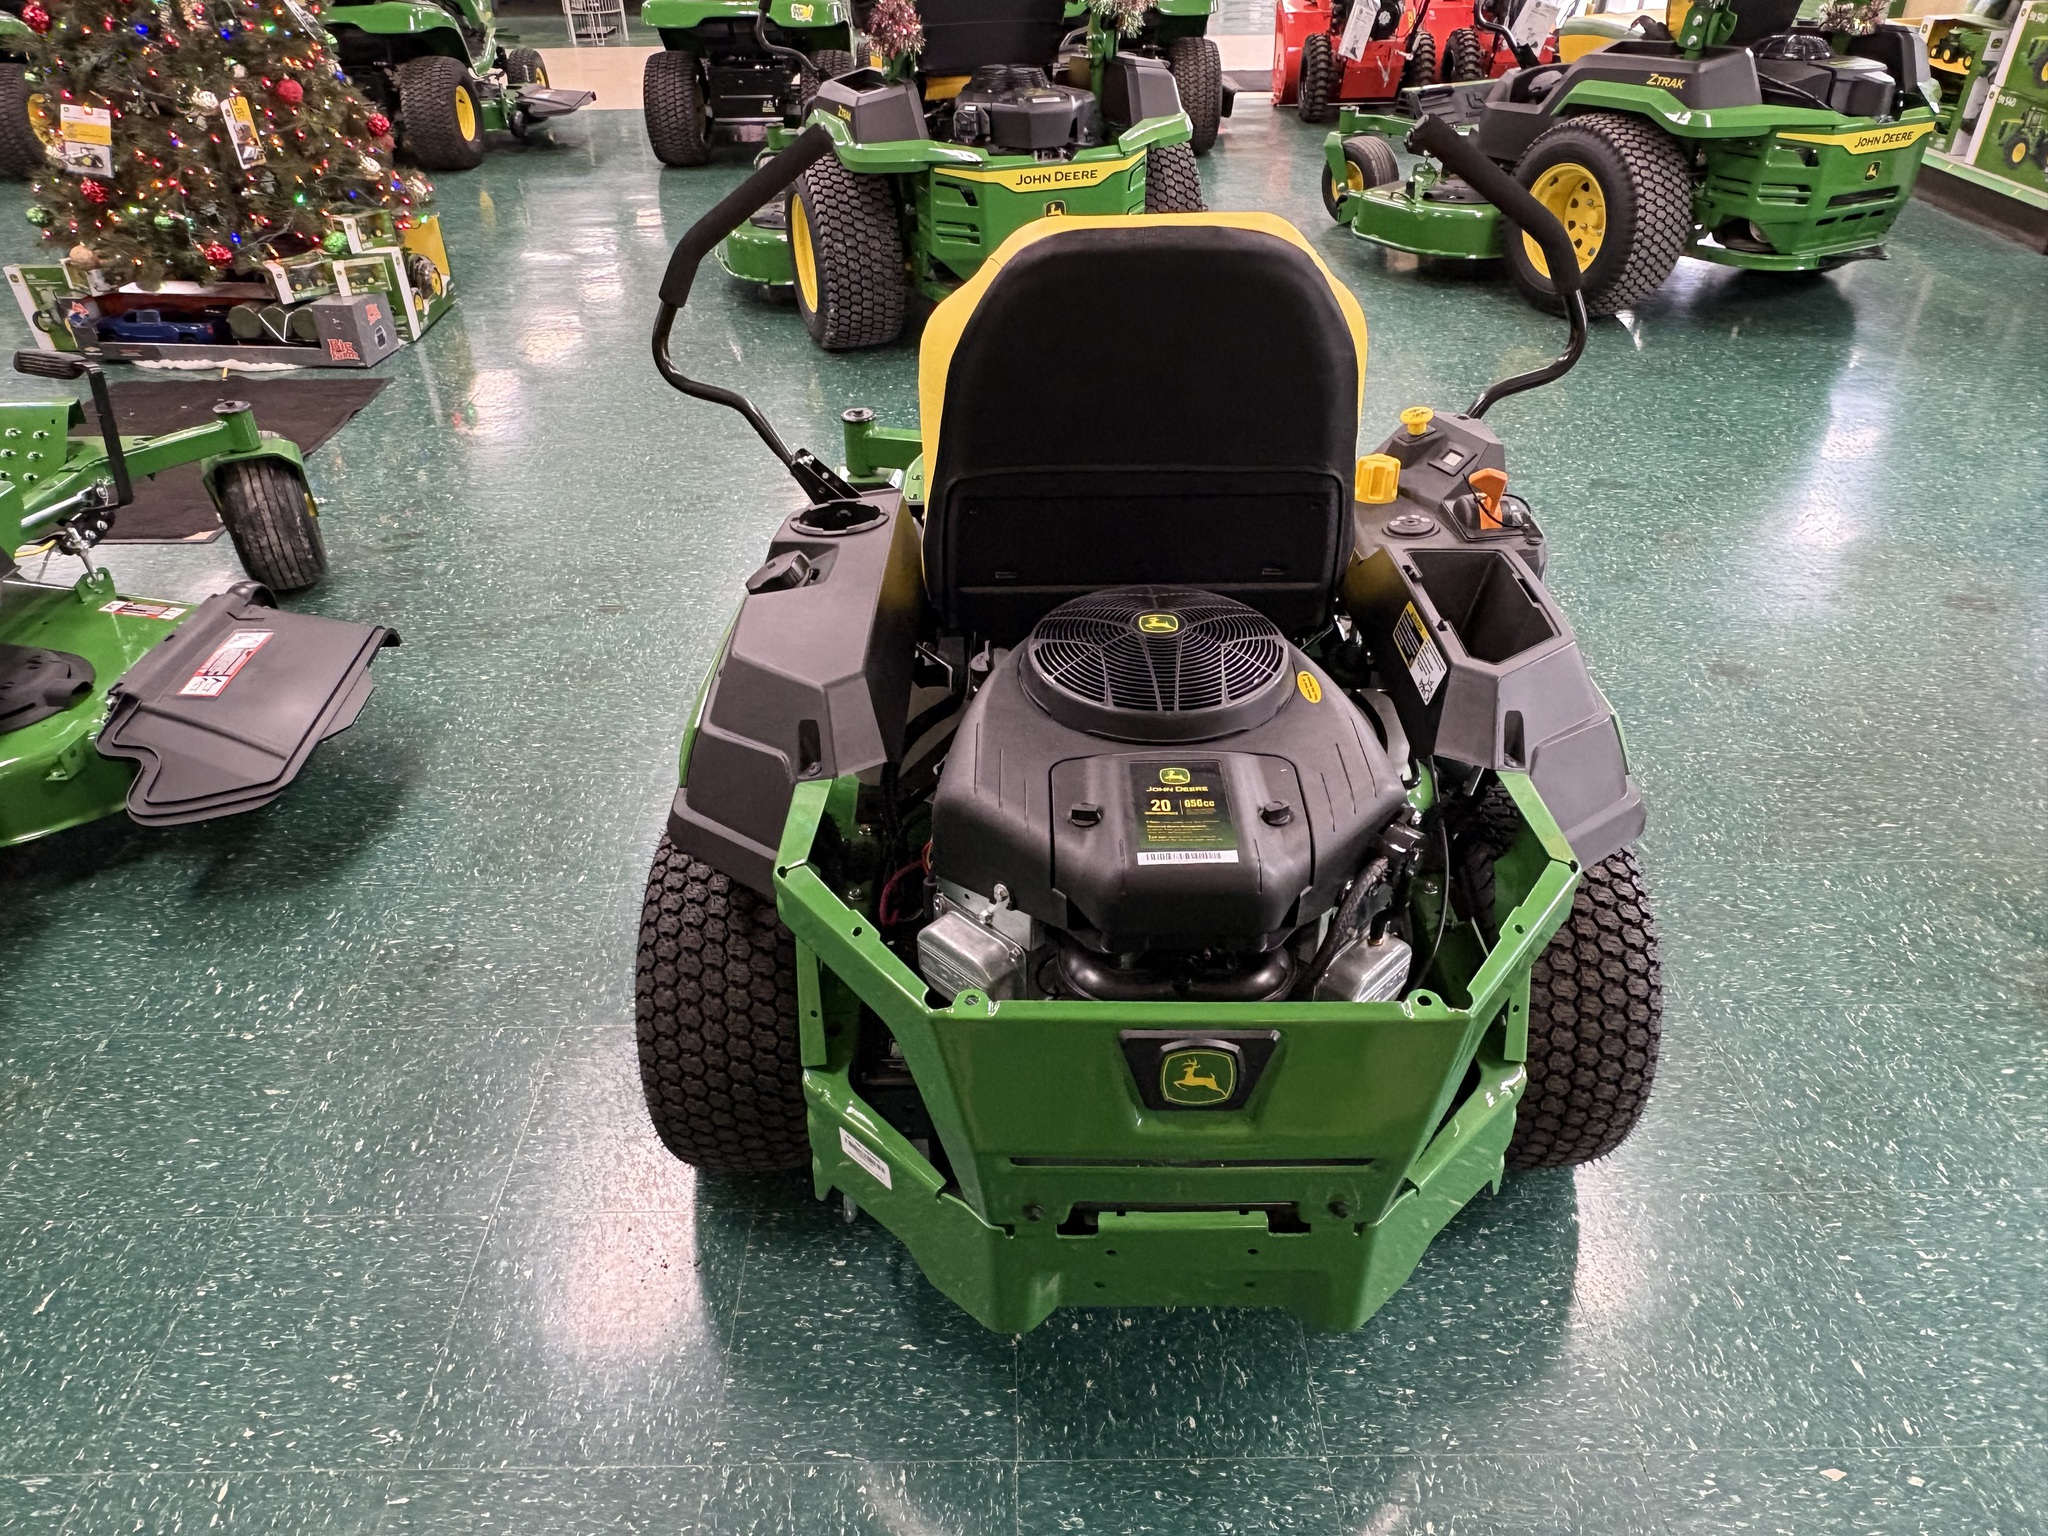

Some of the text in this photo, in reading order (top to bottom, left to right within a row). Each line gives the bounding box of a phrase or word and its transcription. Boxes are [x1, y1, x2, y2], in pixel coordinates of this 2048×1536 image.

[1646, 73, 1686, 90] ZTRAK
[1854, 131, 1914, 148] JOHN DEERE
[1016, 169, 1098, 186] JOHN DEERE
[1150, 799, 1172, 812] 20
